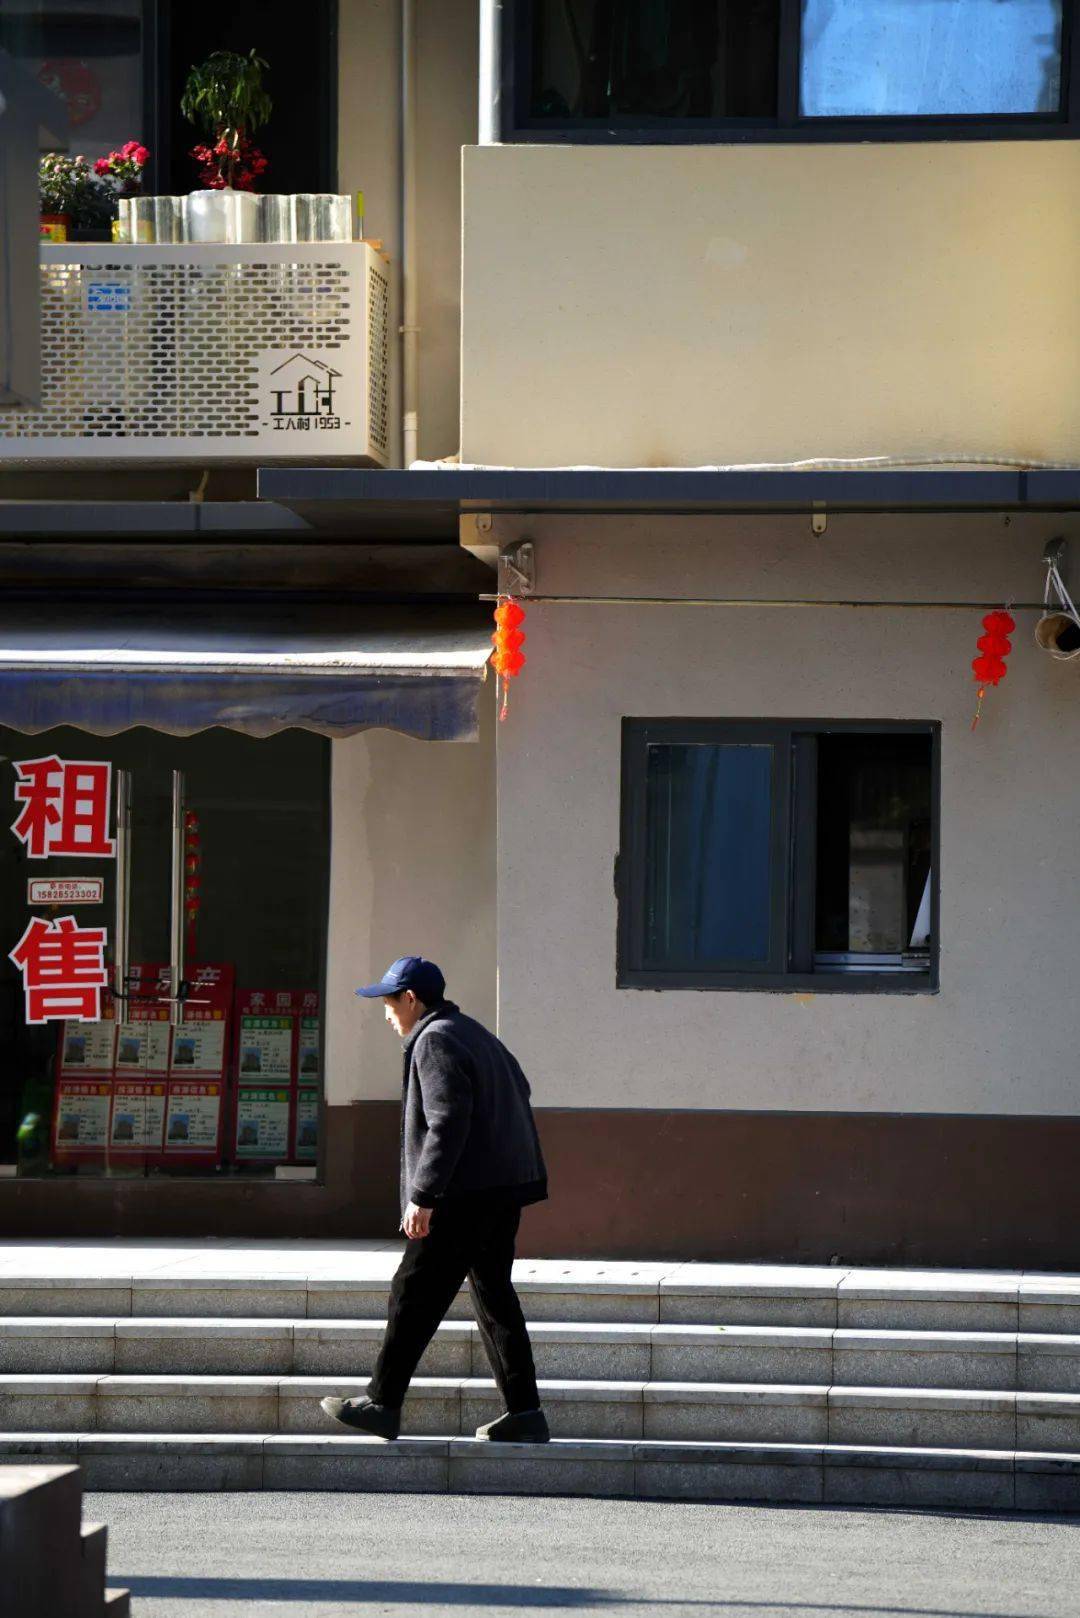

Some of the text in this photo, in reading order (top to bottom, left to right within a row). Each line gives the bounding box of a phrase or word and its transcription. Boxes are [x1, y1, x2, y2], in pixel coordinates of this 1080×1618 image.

[273, 417, 341, 431] 工人村 1953
[11, 755, 117, 858] 租
[9, 917, 107, 1025] 售
